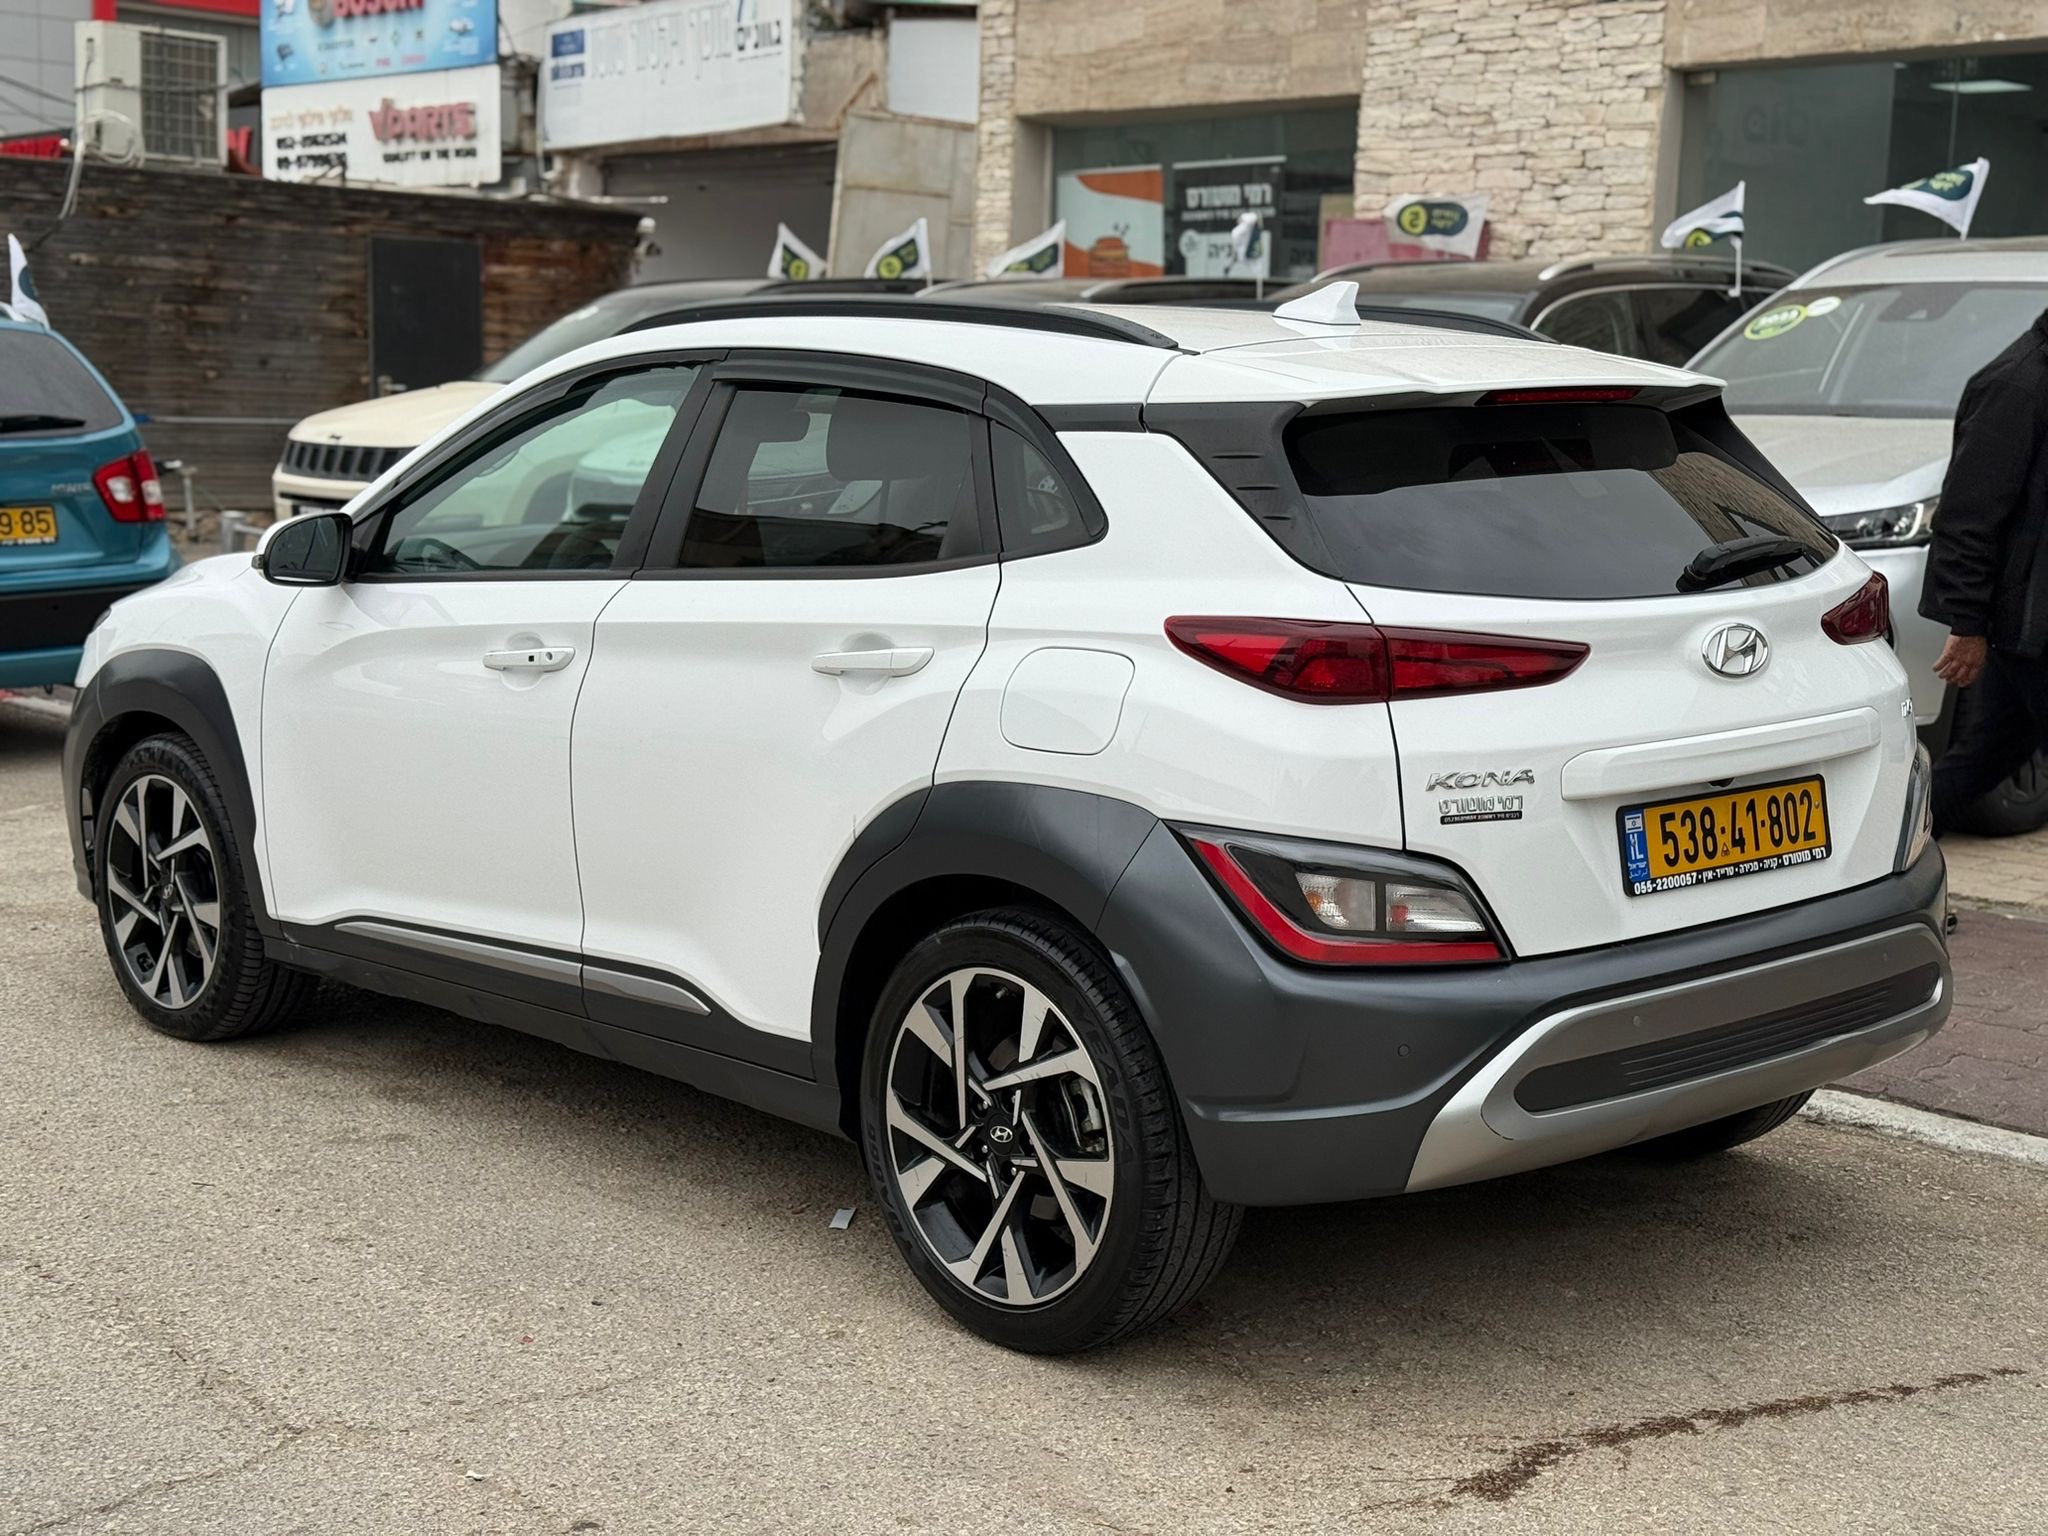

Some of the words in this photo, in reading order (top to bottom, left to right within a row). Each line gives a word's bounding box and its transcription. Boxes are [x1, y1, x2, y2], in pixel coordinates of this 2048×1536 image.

[1425, 769, 1535, 792] KONA
[1439, 796, 1494, 814] מוטורס
[1497, 795, 1523, 810] רמי
[1630, 833, 1644, 860] IL
[1812, 847, 1826, 859] רמי
[1763, 857, 1778, 869] קניה
[1782, 850, 1811, 866] מוטורס
[1739, 861, 1759, 874] מכירה
[1634, 872, 1697, 894] 055-2200057
